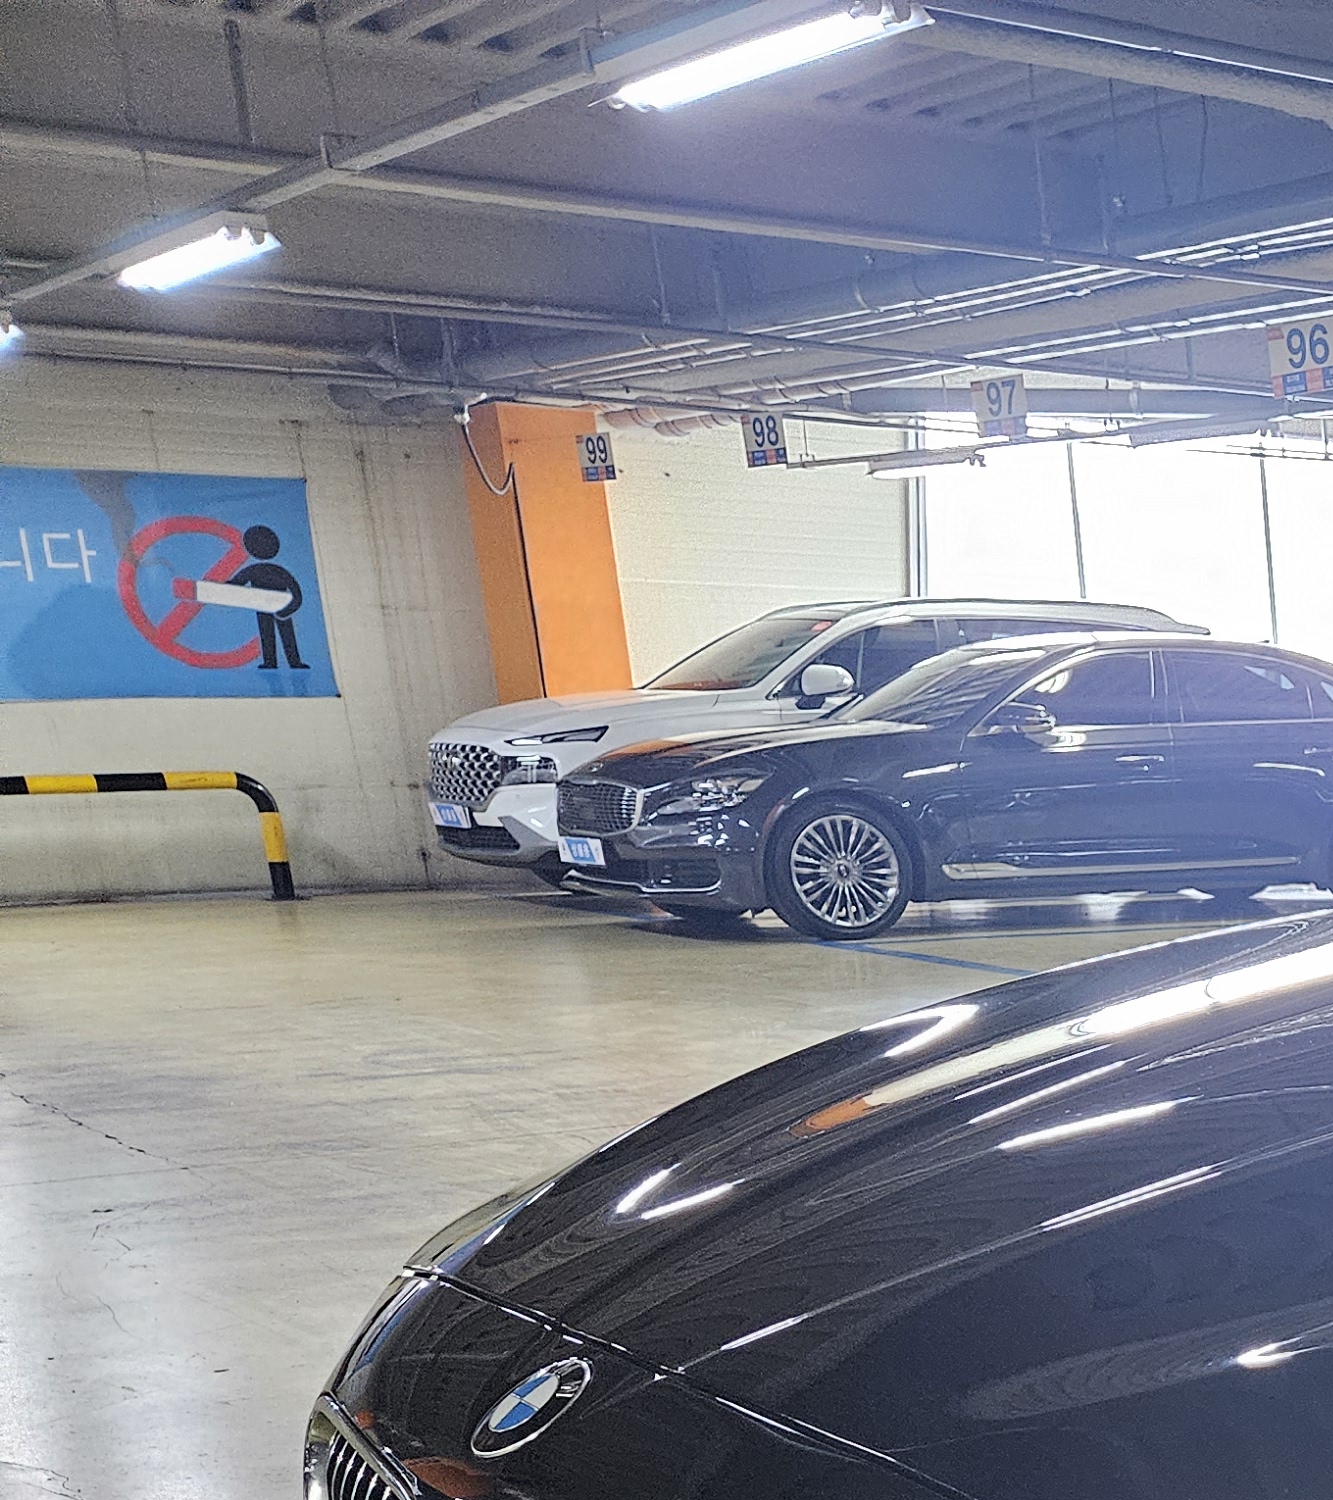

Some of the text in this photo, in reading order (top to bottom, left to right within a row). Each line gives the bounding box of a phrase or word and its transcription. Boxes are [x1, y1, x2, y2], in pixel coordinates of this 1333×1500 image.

[1286, 323, 1330, 369] 96
[985, 379, 1016, 417] 97
[752, 415, 780, 448] 98
[585, 435, 608, 464] 99
